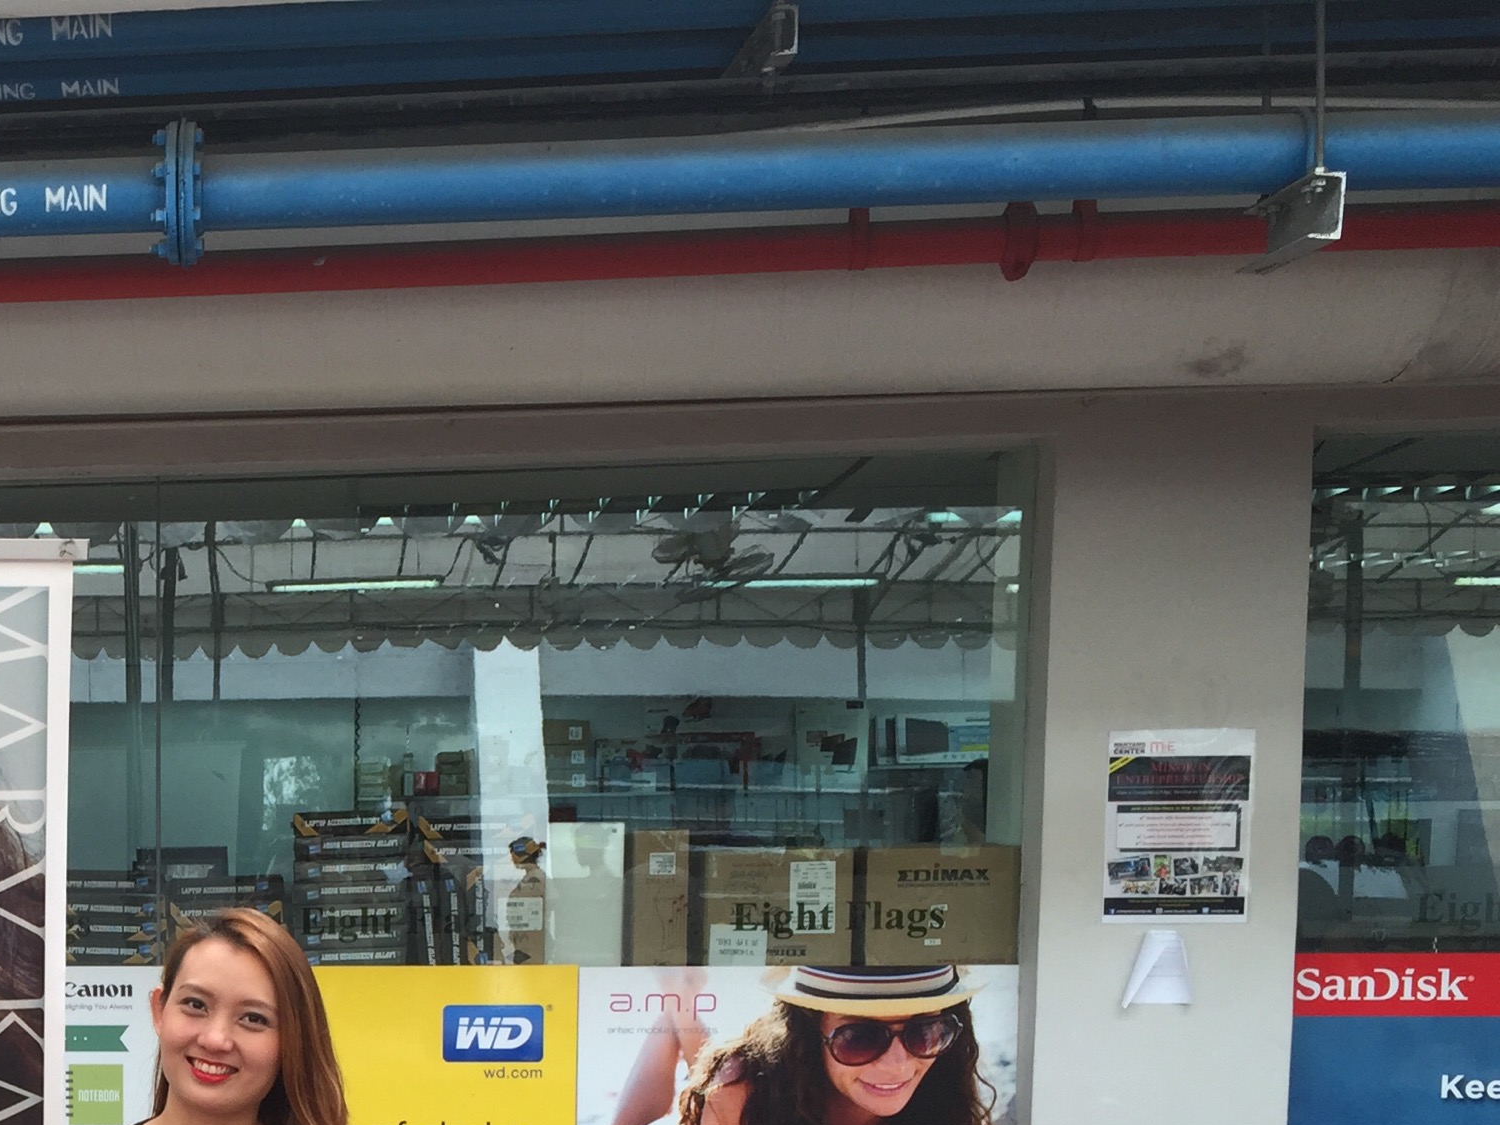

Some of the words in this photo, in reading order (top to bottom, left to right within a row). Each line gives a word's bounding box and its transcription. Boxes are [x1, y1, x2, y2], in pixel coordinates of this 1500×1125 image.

[51, 14, 114, 41] MAIN
[60, 77, 120, 97] MAIN
[45, 184, 108, 213] MAIN
[301, 906, 398, 943] Eight
[732, 901, 833, 939] Eight
[845, 900, 945, 938] Flags
[1413, 892, 1500, 931] Eigh
[65, 982, 133, 998] Canon
[1296, 967, 1469, 1001] SanDisk
[455, 1017, 533, 1050] WD
[484, 1067, 543, 1079] wd.com
[1440, 1074, 1500, 1100] Kee
[78, 1089, 120, 1102] NOTEBOOK
